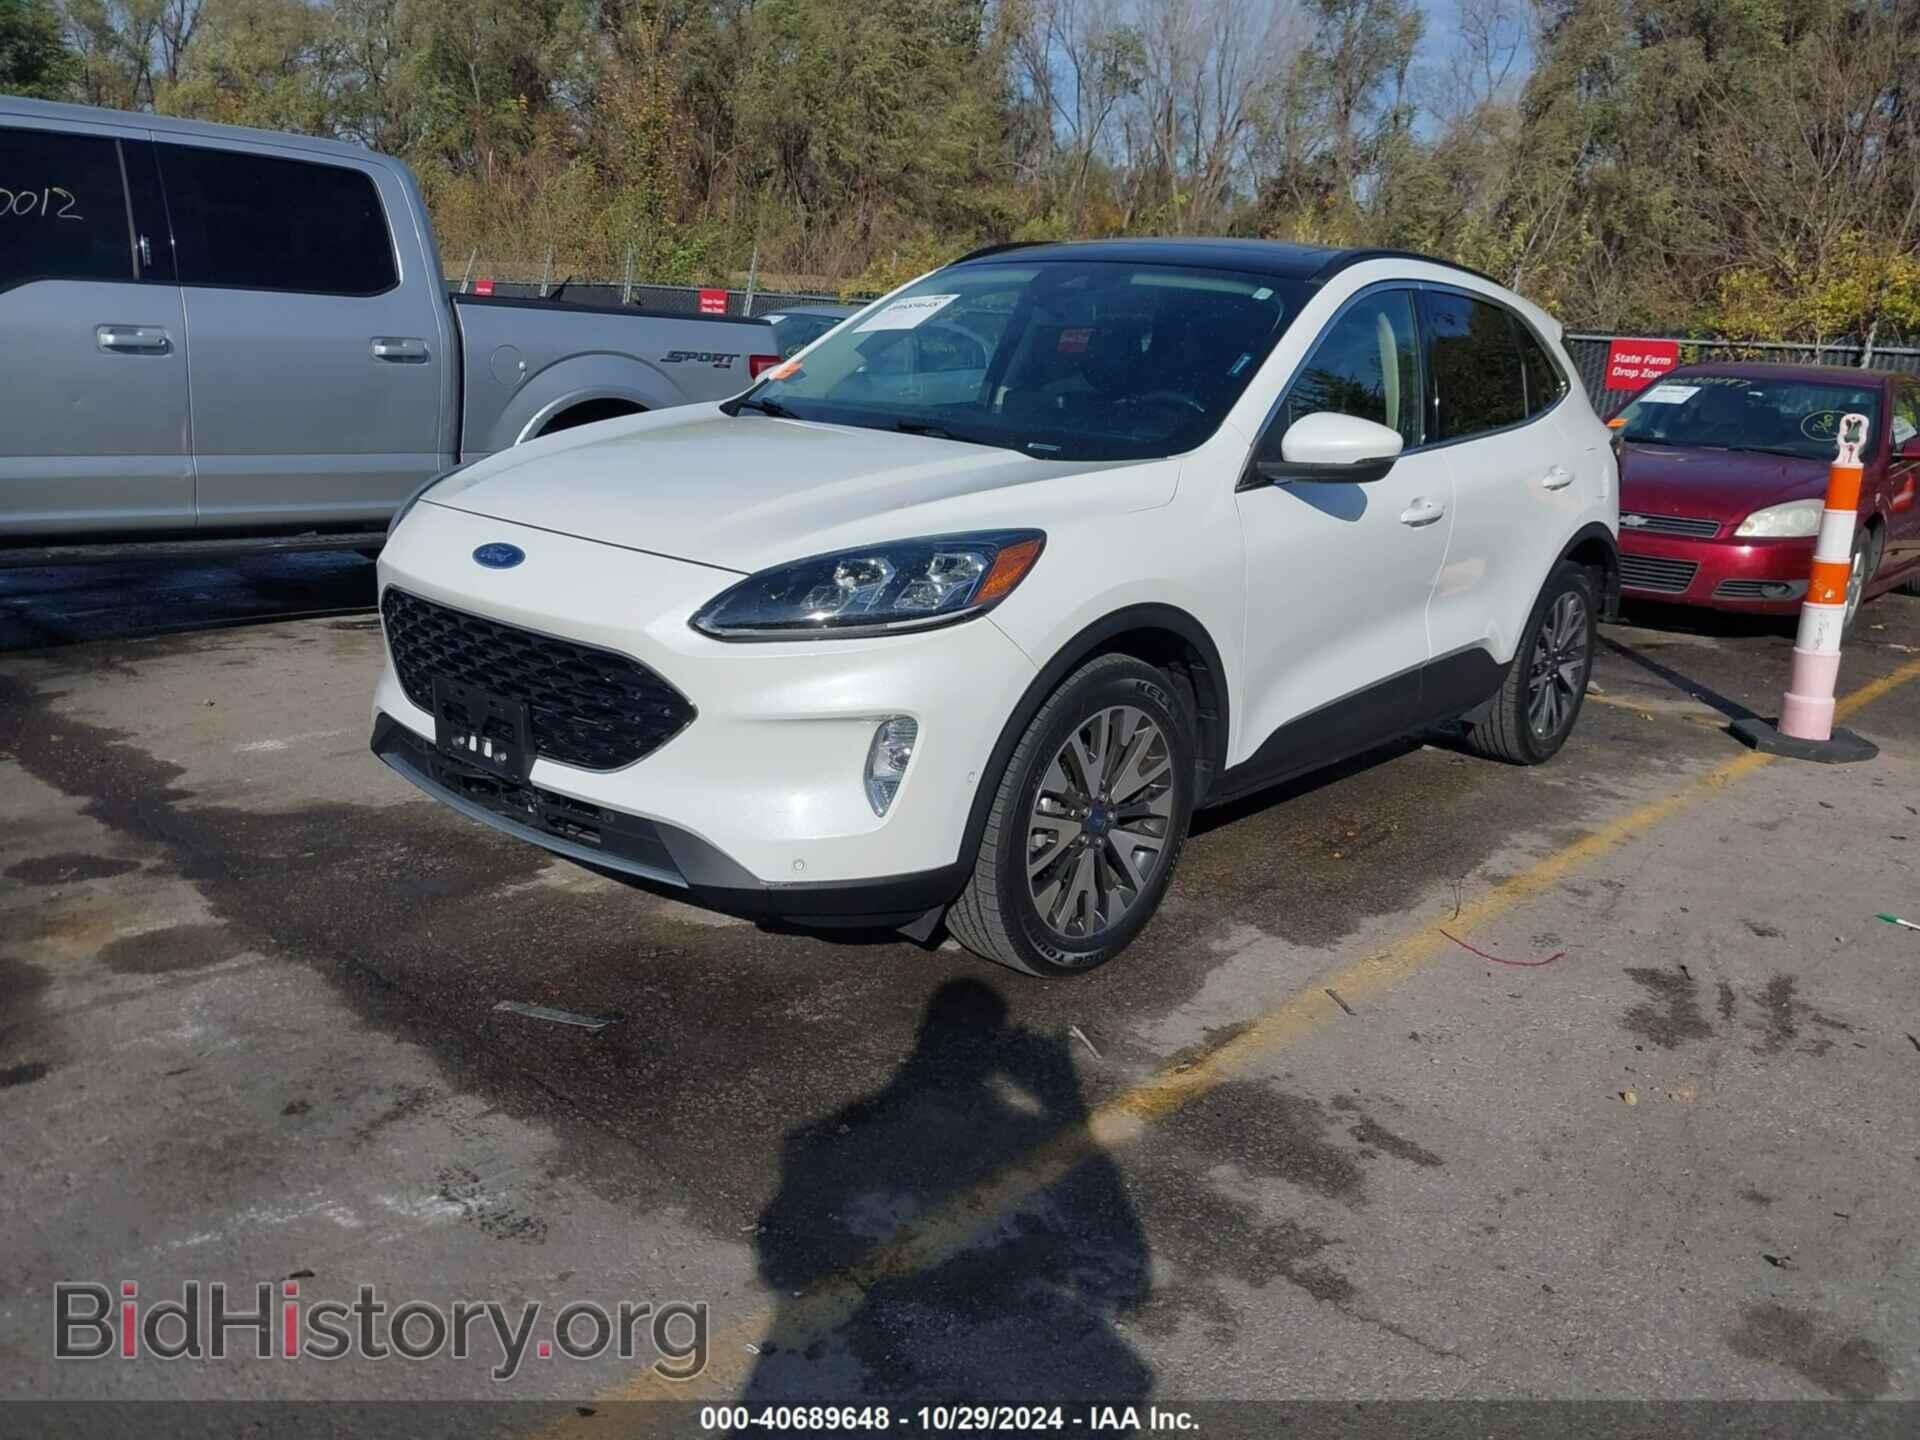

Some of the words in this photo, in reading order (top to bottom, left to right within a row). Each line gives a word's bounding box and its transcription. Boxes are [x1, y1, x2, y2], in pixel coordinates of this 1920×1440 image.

[660, 350, 741, 363] SPORT
[1613, 353, 1642, 364] State
[1643, 354, 1672, 366] Farm
[1611, 366, 1639, 379] Drop
